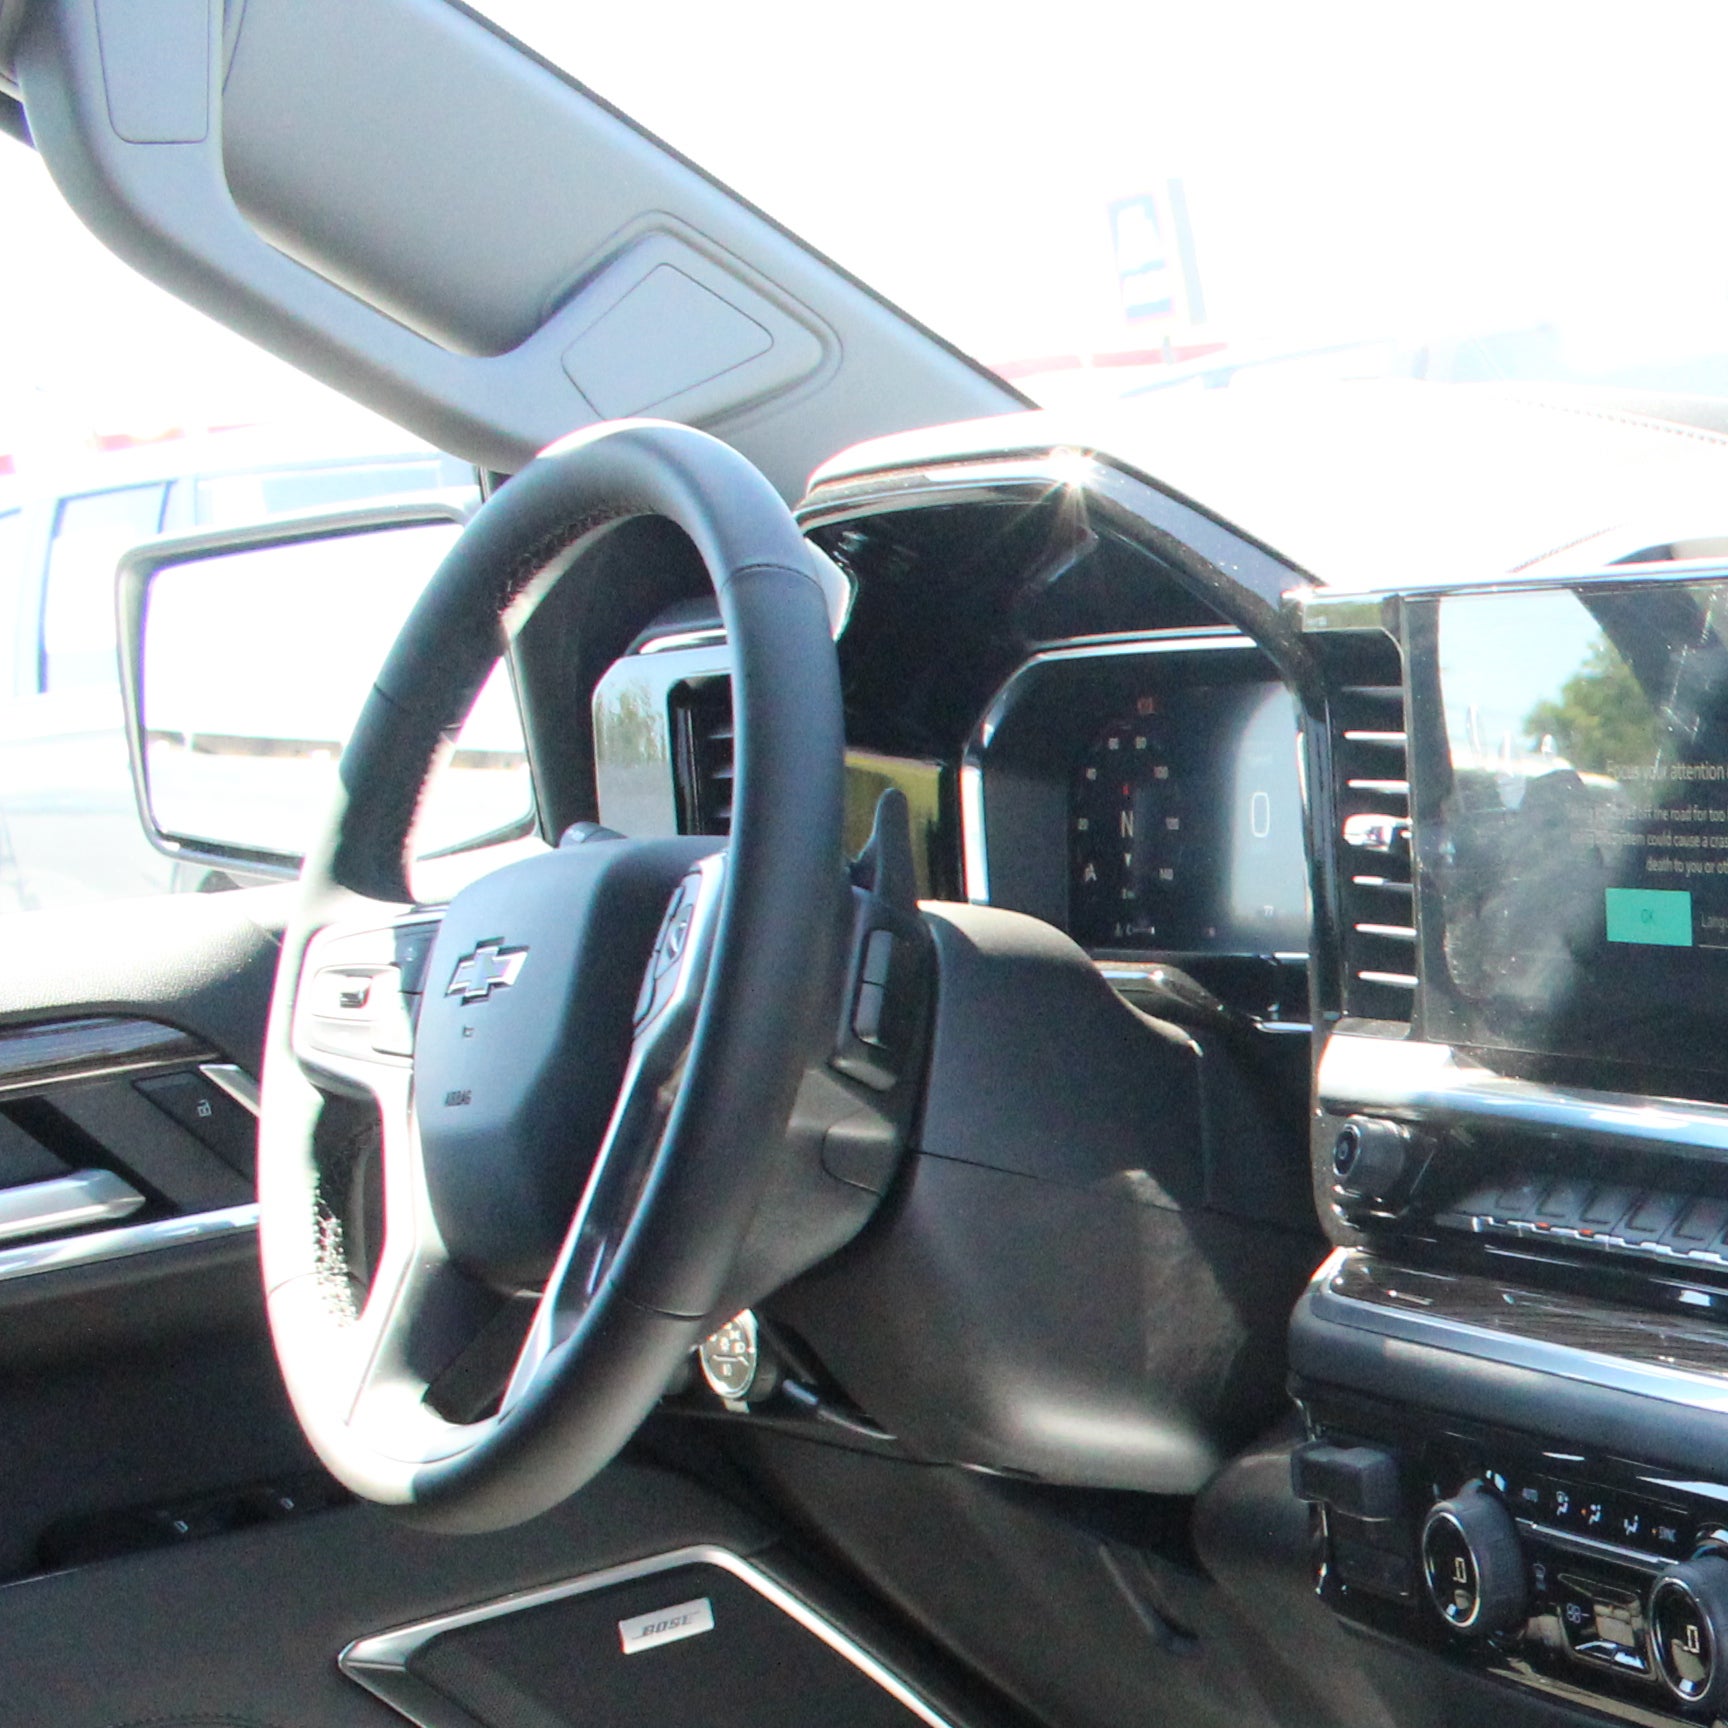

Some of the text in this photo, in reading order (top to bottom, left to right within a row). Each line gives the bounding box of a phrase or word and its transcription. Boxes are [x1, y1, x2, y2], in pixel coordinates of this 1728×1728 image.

[1670, 762, 1726, 782] attention
[1251, 792, 1270, 838] 0
[1670, 805, 1692, 823] road
[1692, 804, 1707, 822] for
[1709, 807, 1726, 823] too
[1647, 830, 1672, 846] could
[1674, 834, 1700, 848] cause
[1646, 857, 1674, 873] death
[1675, 860, 1683, 873] to
[1685, 862, 1703, 878] you
[1704, 862, 1715, 874] or
